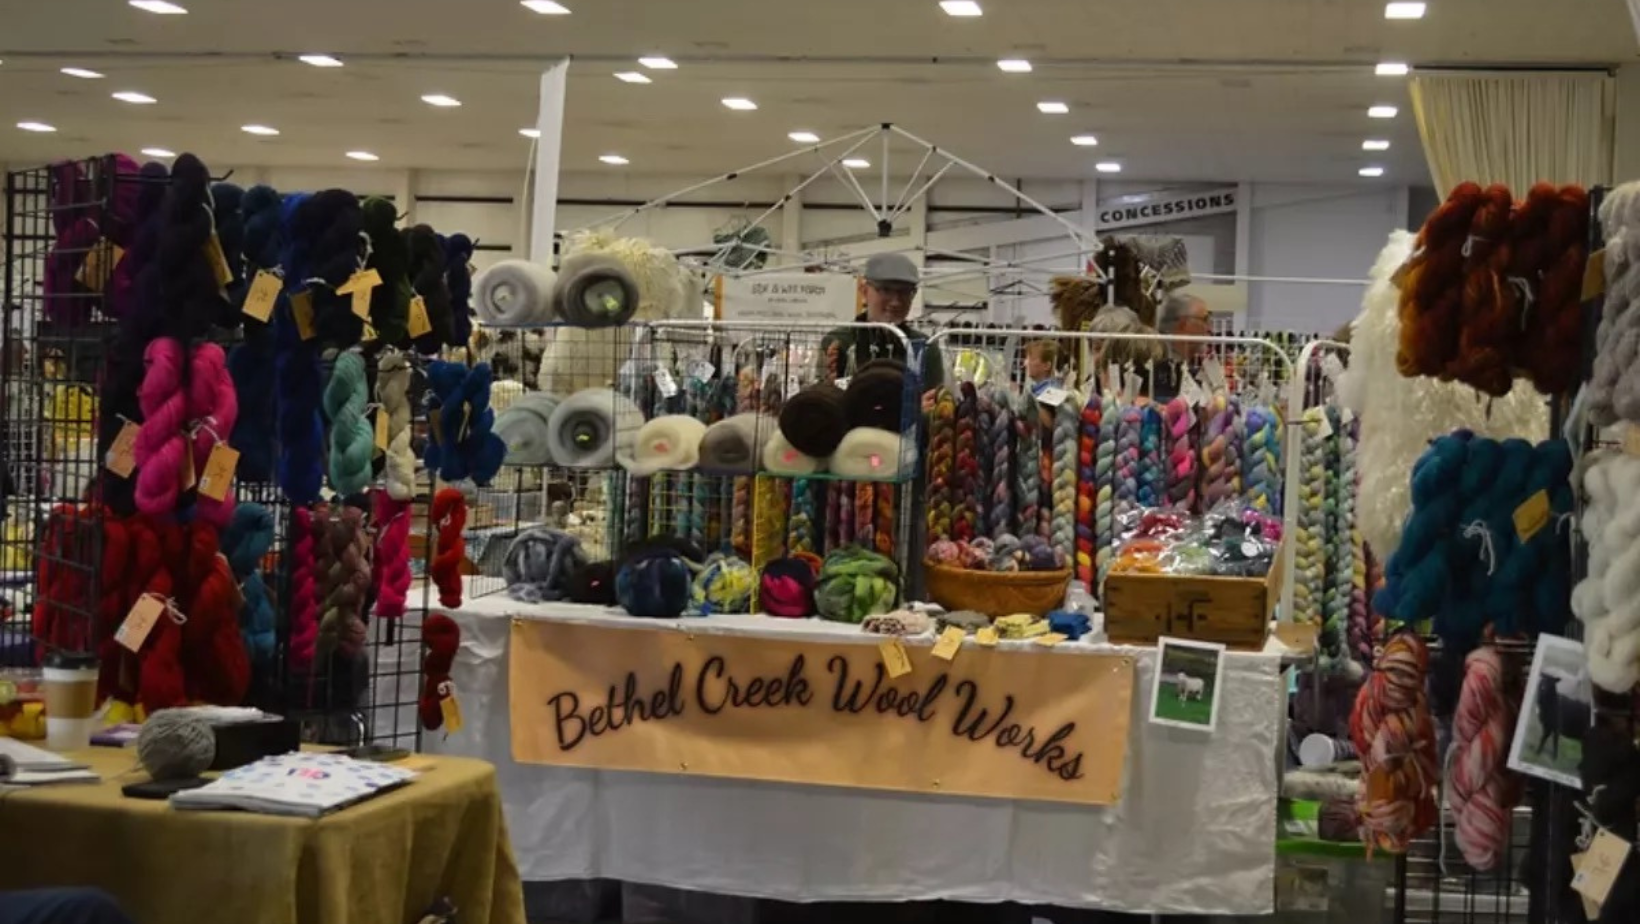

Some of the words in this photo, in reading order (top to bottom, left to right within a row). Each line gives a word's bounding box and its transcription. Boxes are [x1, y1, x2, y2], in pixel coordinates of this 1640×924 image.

[1100, 193, 1236, 223] CONCESSIONS
[546, 661, 687, 752] Bethel
[693, 653, 816, 719] Creek
[825, 655, 950, 723] Wool
[950, 678, 1085, 782] Works
